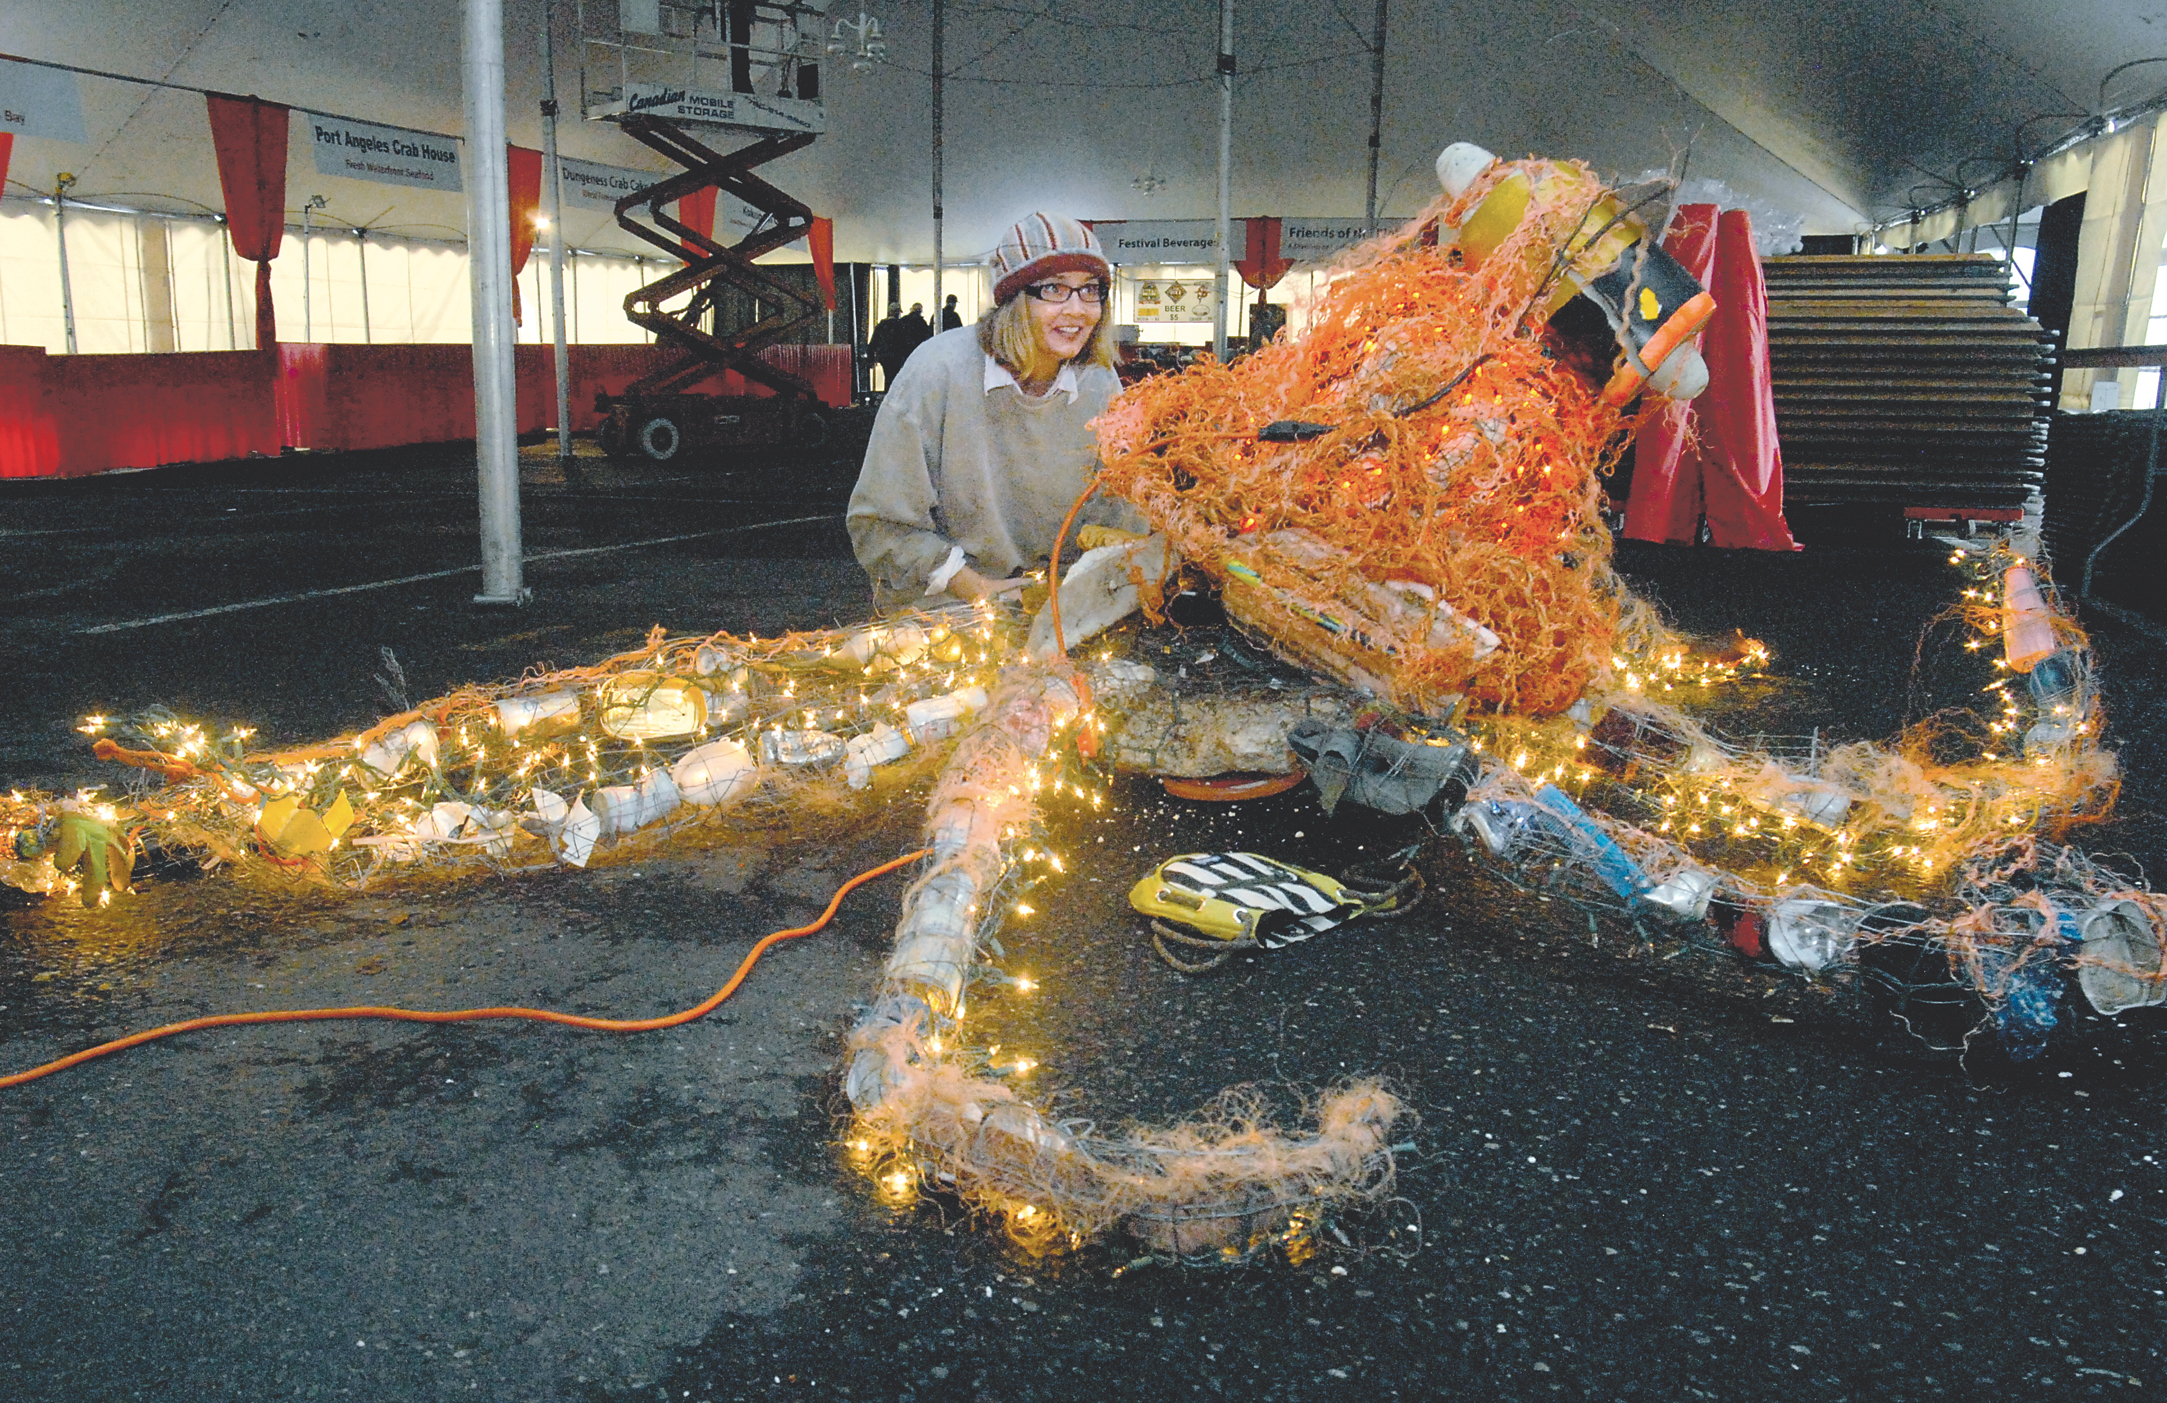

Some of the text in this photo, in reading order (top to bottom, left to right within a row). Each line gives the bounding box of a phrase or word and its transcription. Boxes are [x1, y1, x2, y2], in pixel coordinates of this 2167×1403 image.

[629, 88, 734, 112] Canadian MOBILE
[5, 110, 25, 126] Bay
[677, 105, 734, 119] STORAGE
[315, 126, 456, 163] Port Angeles Crab House
[562, 167, 608, 186] Dungeness
[609, 176, 629, 190] Crab
[1289, 226, 1334, 239] Friends
[1337, 227, 1352, 239] of
[1118, 238, 1160, 249] Festival
[1170, 313, 1179, 321] $5
